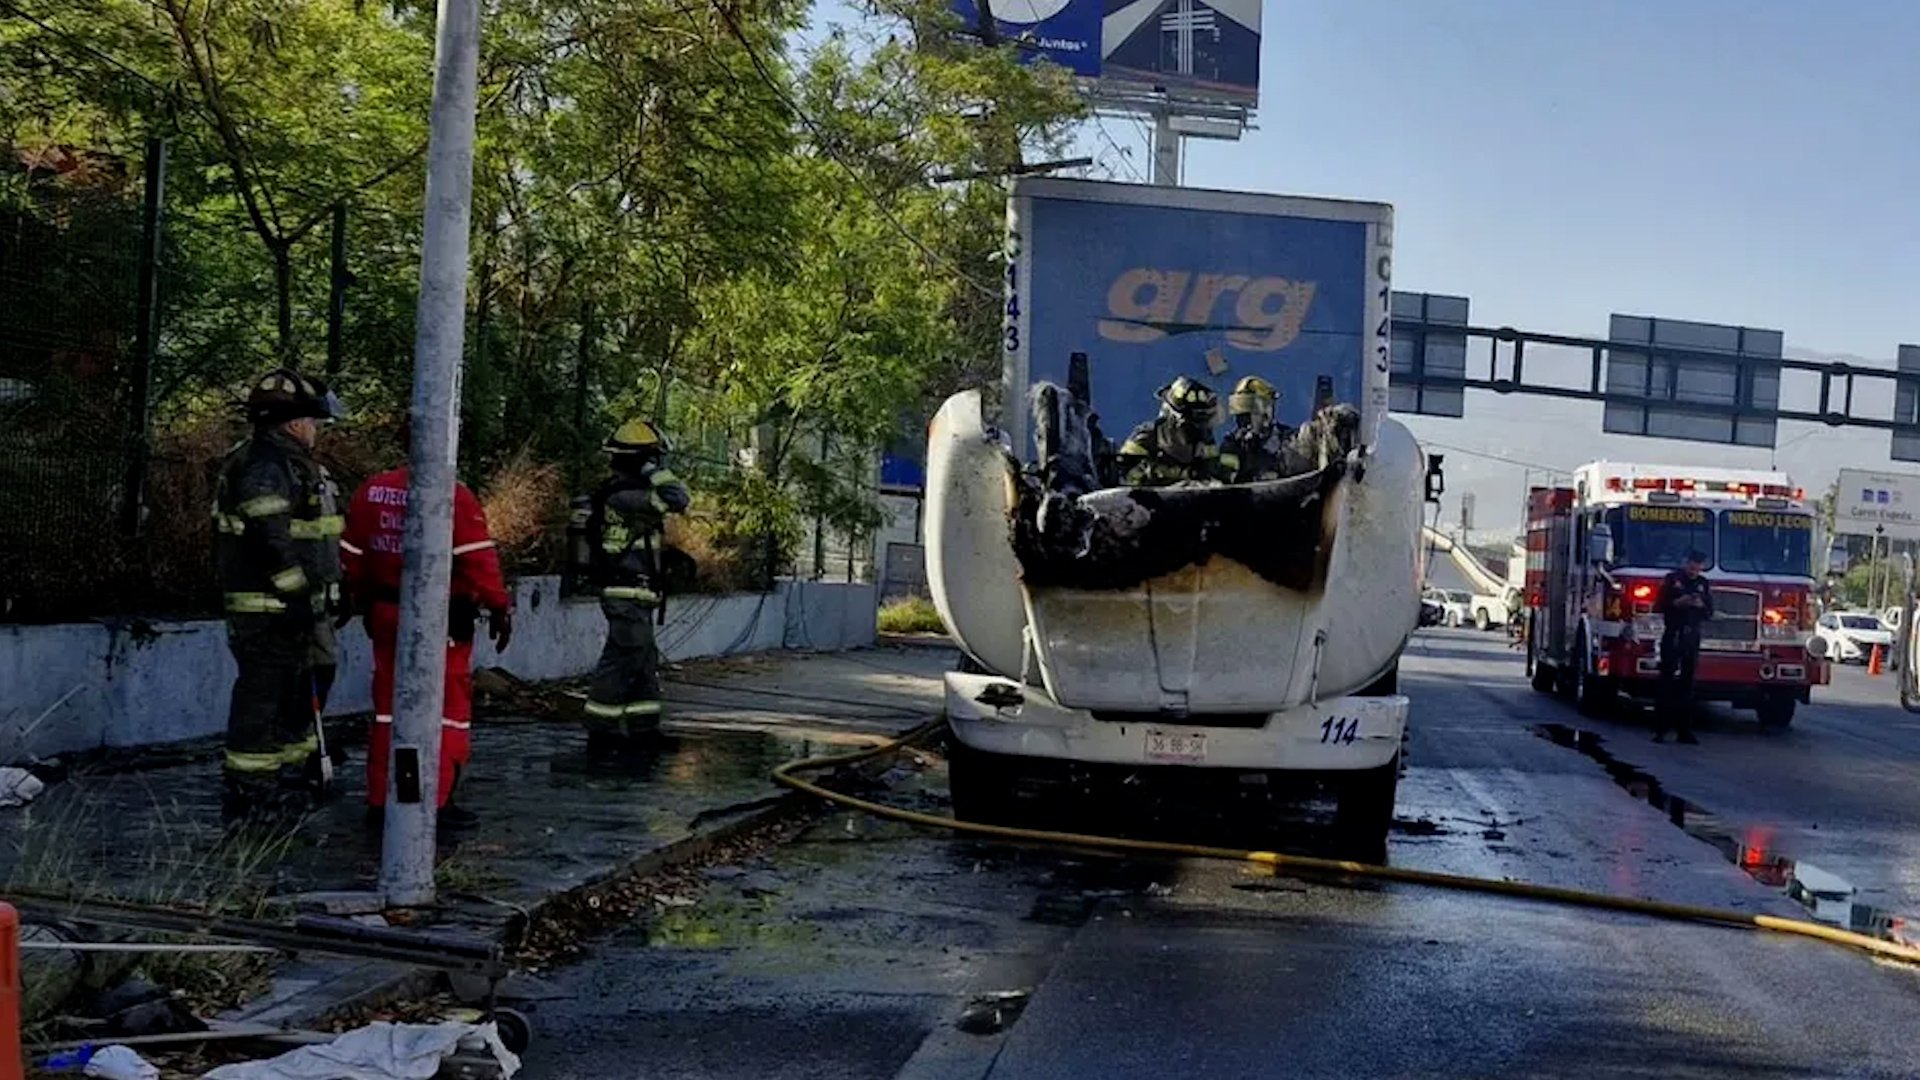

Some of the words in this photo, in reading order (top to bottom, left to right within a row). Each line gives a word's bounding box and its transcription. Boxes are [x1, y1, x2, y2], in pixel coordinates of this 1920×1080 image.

[1098, 268, 1316, 350] arg
[1629, 506, 1706, 524] BOMBEROS
[1728, 512, 1775, 527] NUEVO
[1321, 715, 1358, 746] 114
